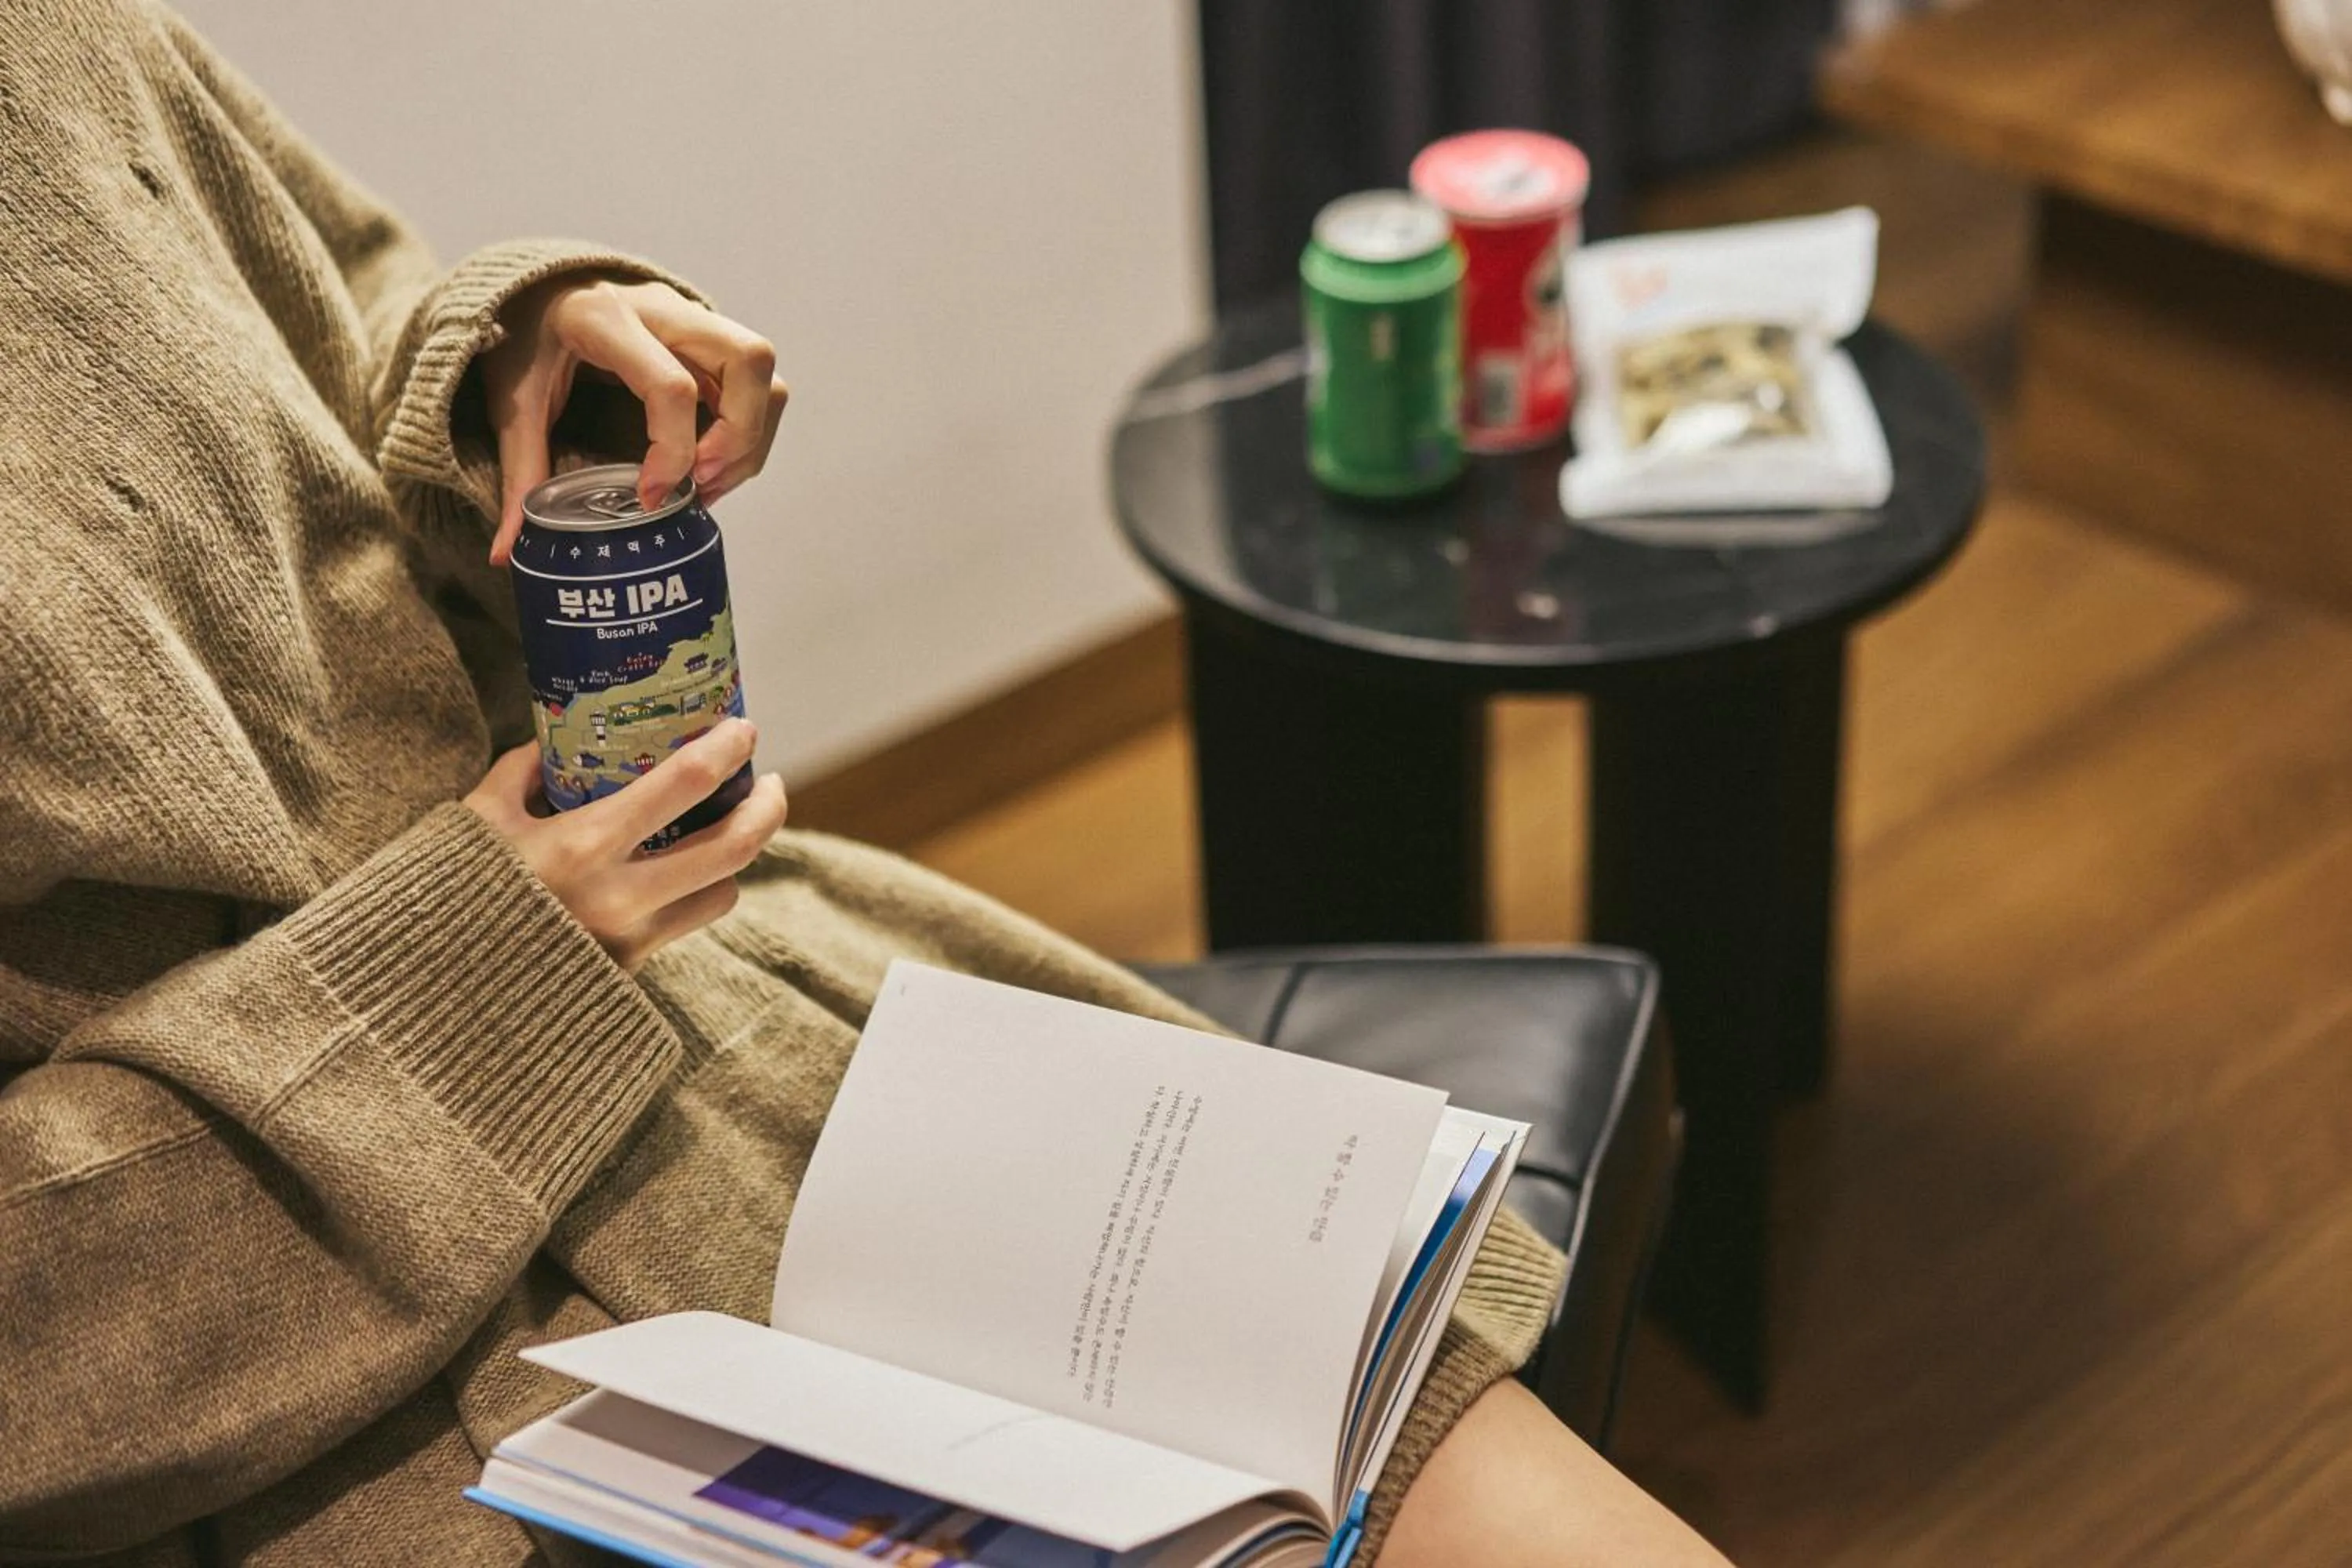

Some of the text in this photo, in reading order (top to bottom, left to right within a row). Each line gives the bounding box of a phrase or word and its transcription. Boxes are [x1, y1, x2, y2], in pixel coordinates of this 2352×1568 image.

[557, 574, 688, 618] 부산 IPA
[597, 622, 658, 639] Busan IPA
